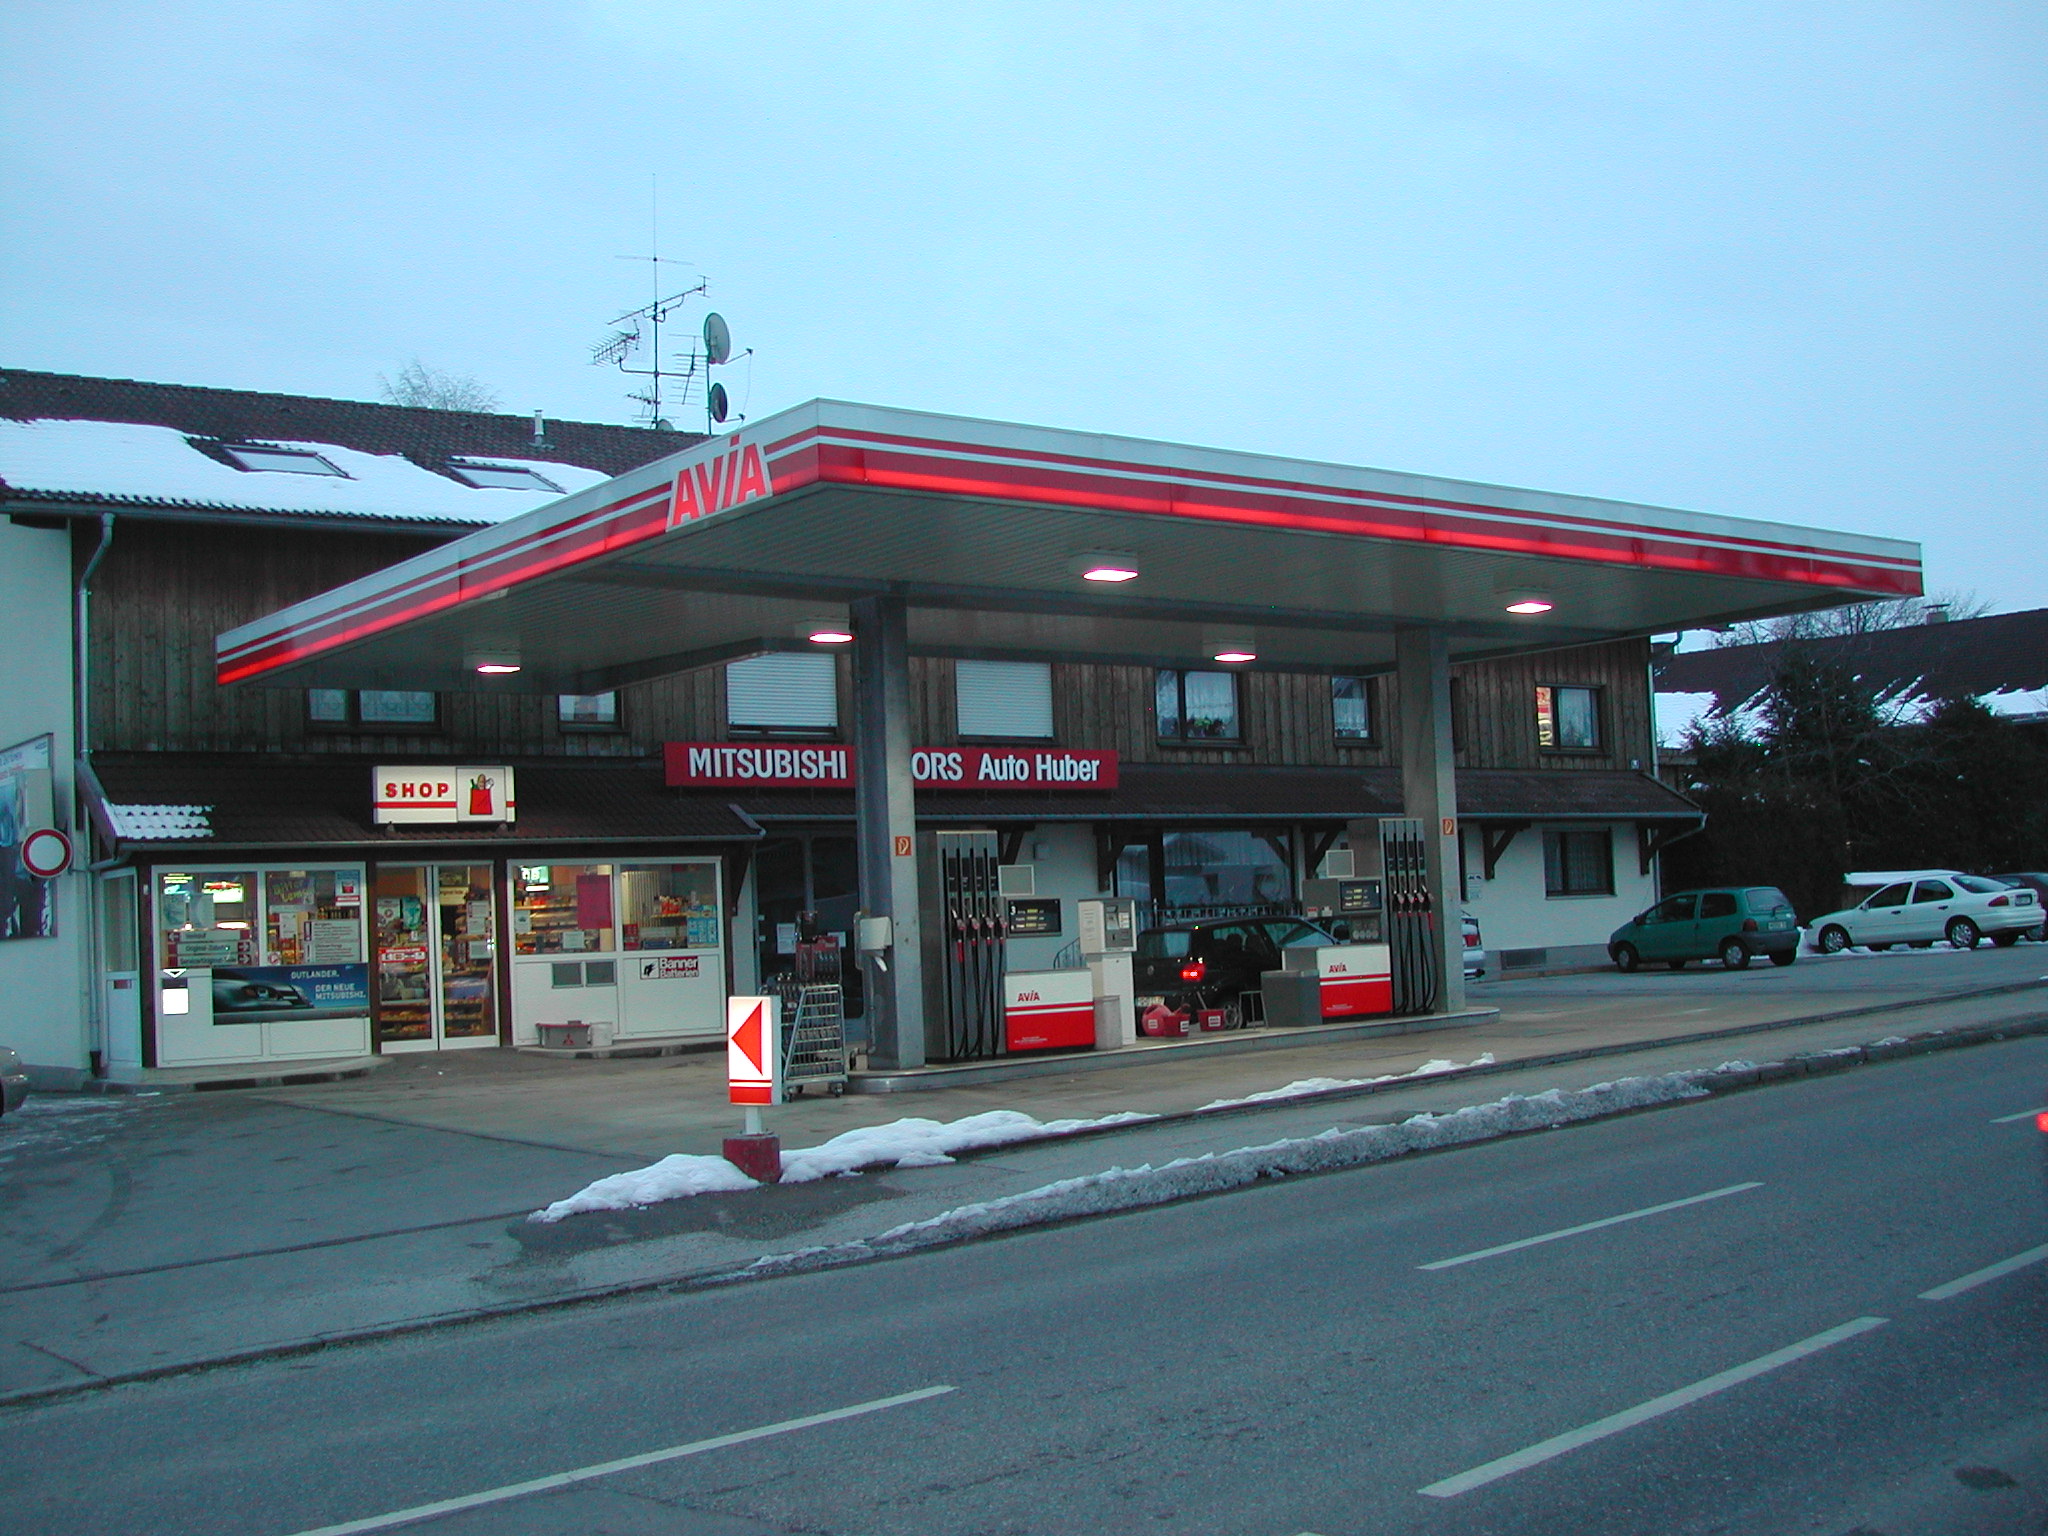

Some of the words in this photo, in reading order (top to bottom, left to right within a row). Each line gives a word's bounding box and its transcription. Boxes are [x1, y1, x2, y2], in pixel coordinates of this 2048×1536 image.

[672, 434, 767, 526] AVIA
[688, 747, 847, 779] MITSUBISHI
[911, 751, 963, 781] ORS
[978, 752, 1029, 781] Auto
[1035, 753, 1100, 782] Huber
[385, 782, 450, 798] SHOP
[1010, 905, 1017, 916] 3
[659, 957, 698, 969] Banner
[1328, 962, 1347, 973] AVIA
[290, 969, 340, 980] OUTLANDER.
[660, 968, 699, 978] Batterien
[315, 984, 332, 992] DER
[333, 983, 356, 991] NEUE
[1017, 990, 1040, 1002] AVIA
